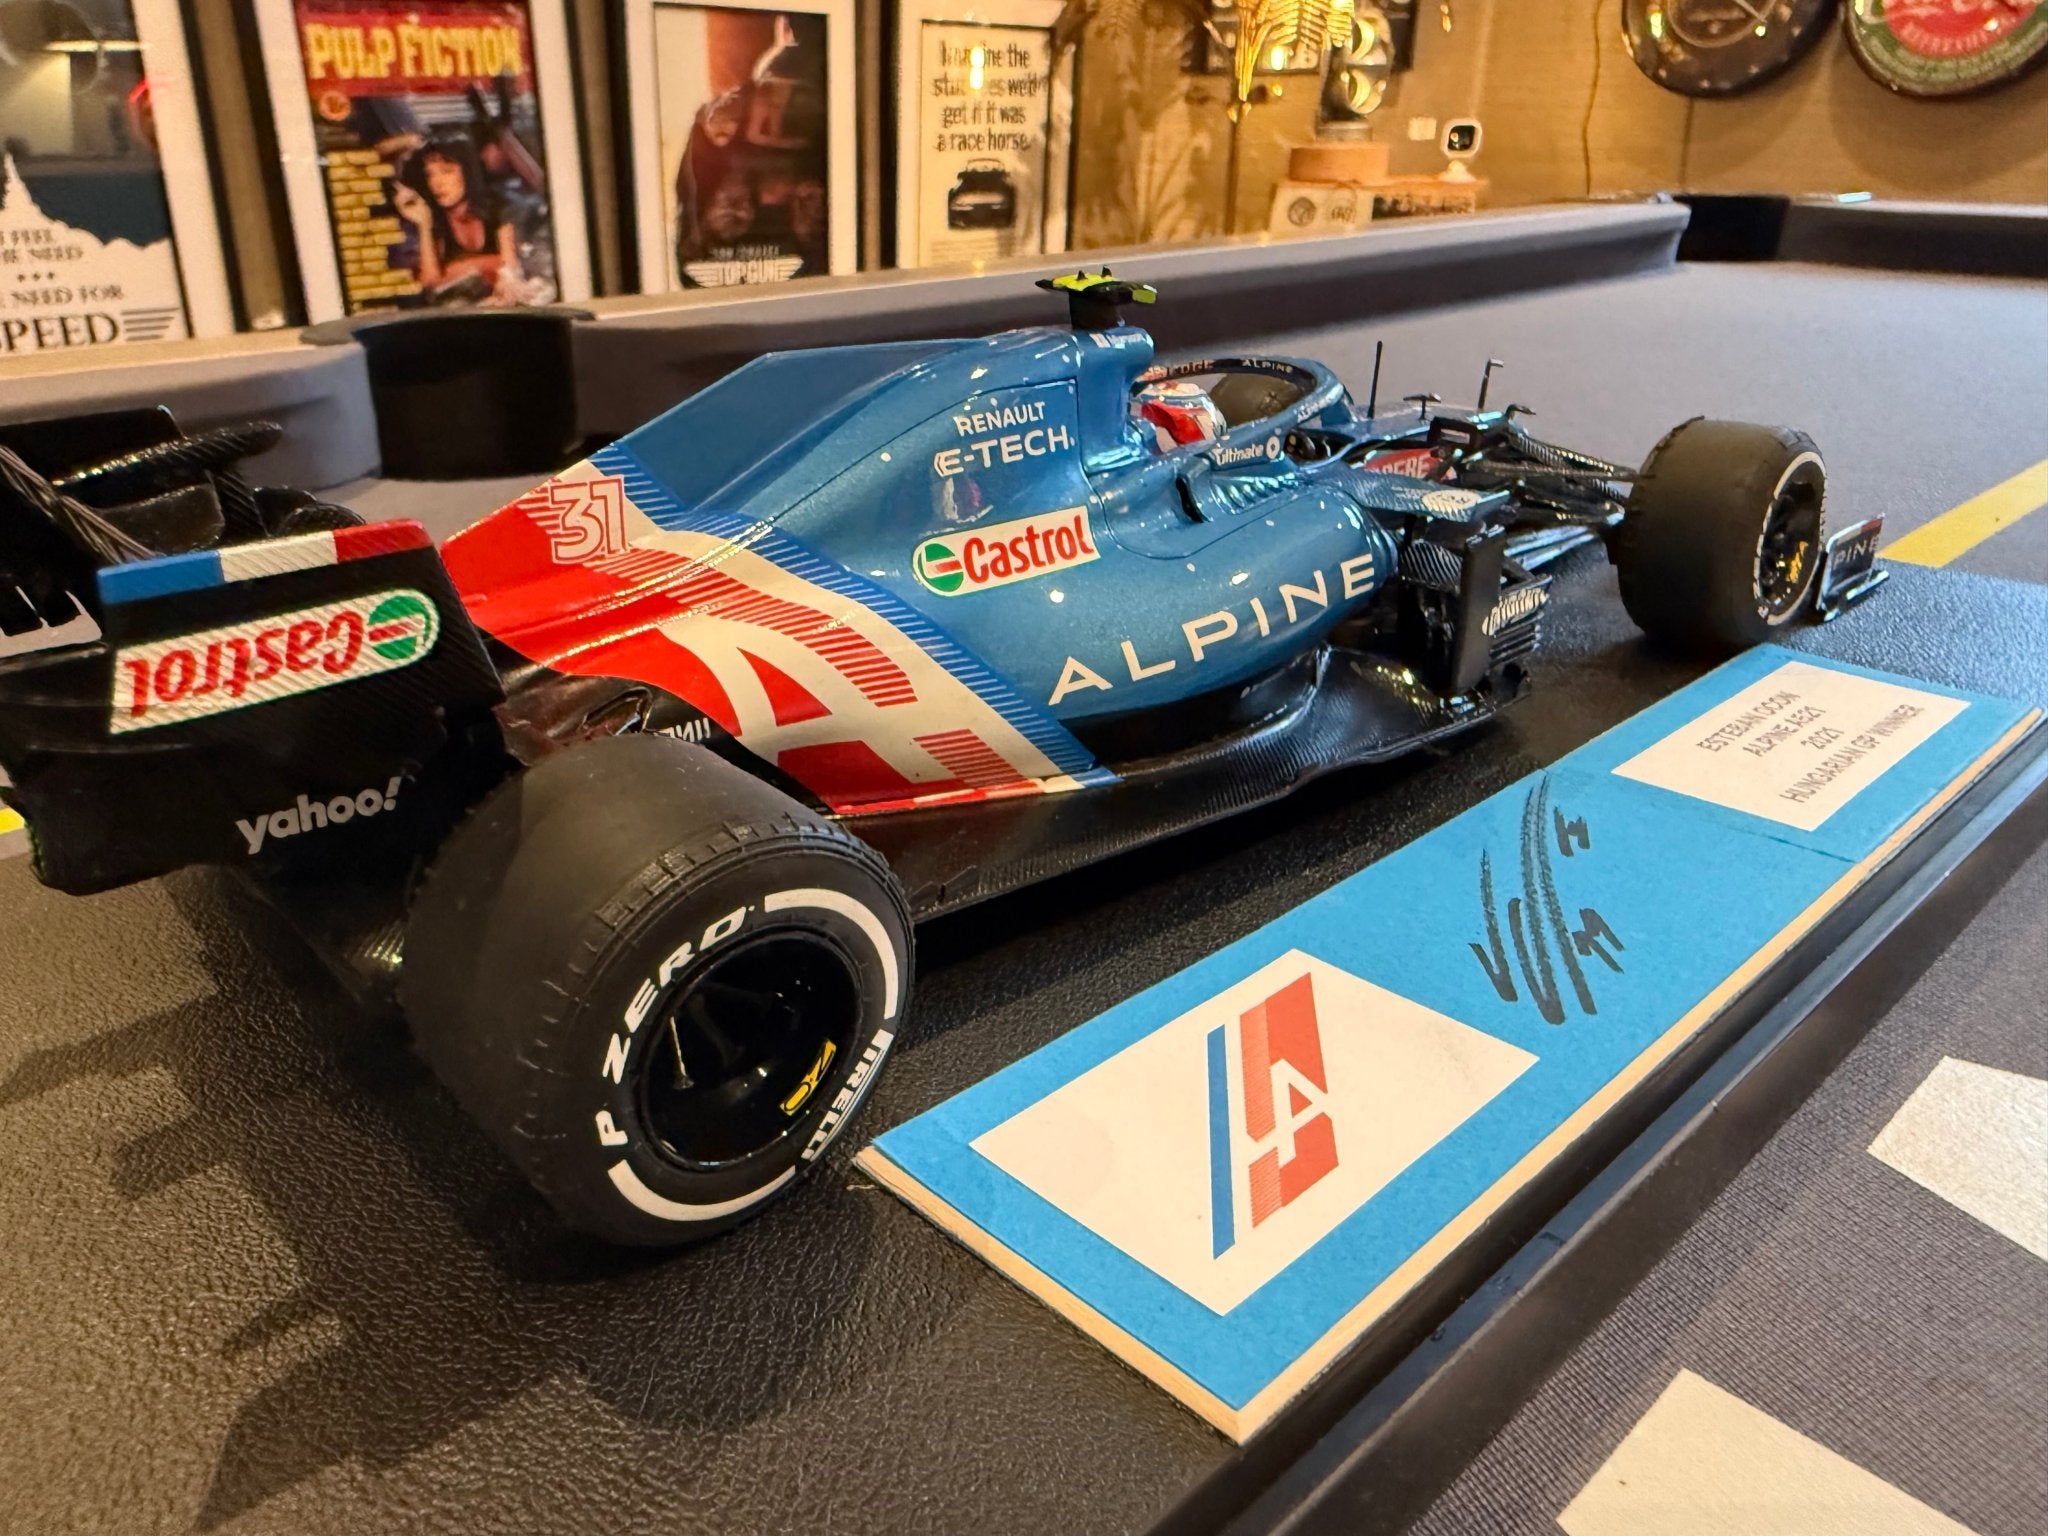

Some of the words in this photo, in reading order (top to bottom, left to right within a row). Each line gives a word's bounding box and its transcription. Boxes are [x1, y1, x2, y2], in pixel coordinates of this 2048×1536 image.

[304, 22, 396, 80] PULP
[397, 23, 523, 79] FICTION
[1007, 43, 1030, 68] the
[936, 133, 947, 152] a
[949, 133, 984, 152] race
[941, 102, 967, 128] get
[1000, 106, 1026, 125] was
[0, 311, 120, 352] PEED
[953, 401, 1045, 437] RENAULT
[934, 424, 1069, 477] E-TECH
[549, 475, 631, 565] 31
[963, 514, 1095, 584] Castrol
[1048, 552, 1375, 705] ALPINE
[124, 610, 365, 718] Castrol
[1696, 712, 1767, 752] ESTEBAN
[1752, 690, 1801, 716] OCON
[1742, 724, 1800, 757] ALPINE
[1800, 727, 1845, 750] 2021
[1779, 746, 1869, 803] HUNGARIAN
[235, 774, 403, 855] yahoo!
[602, 905, 748, 1085] ZERO
